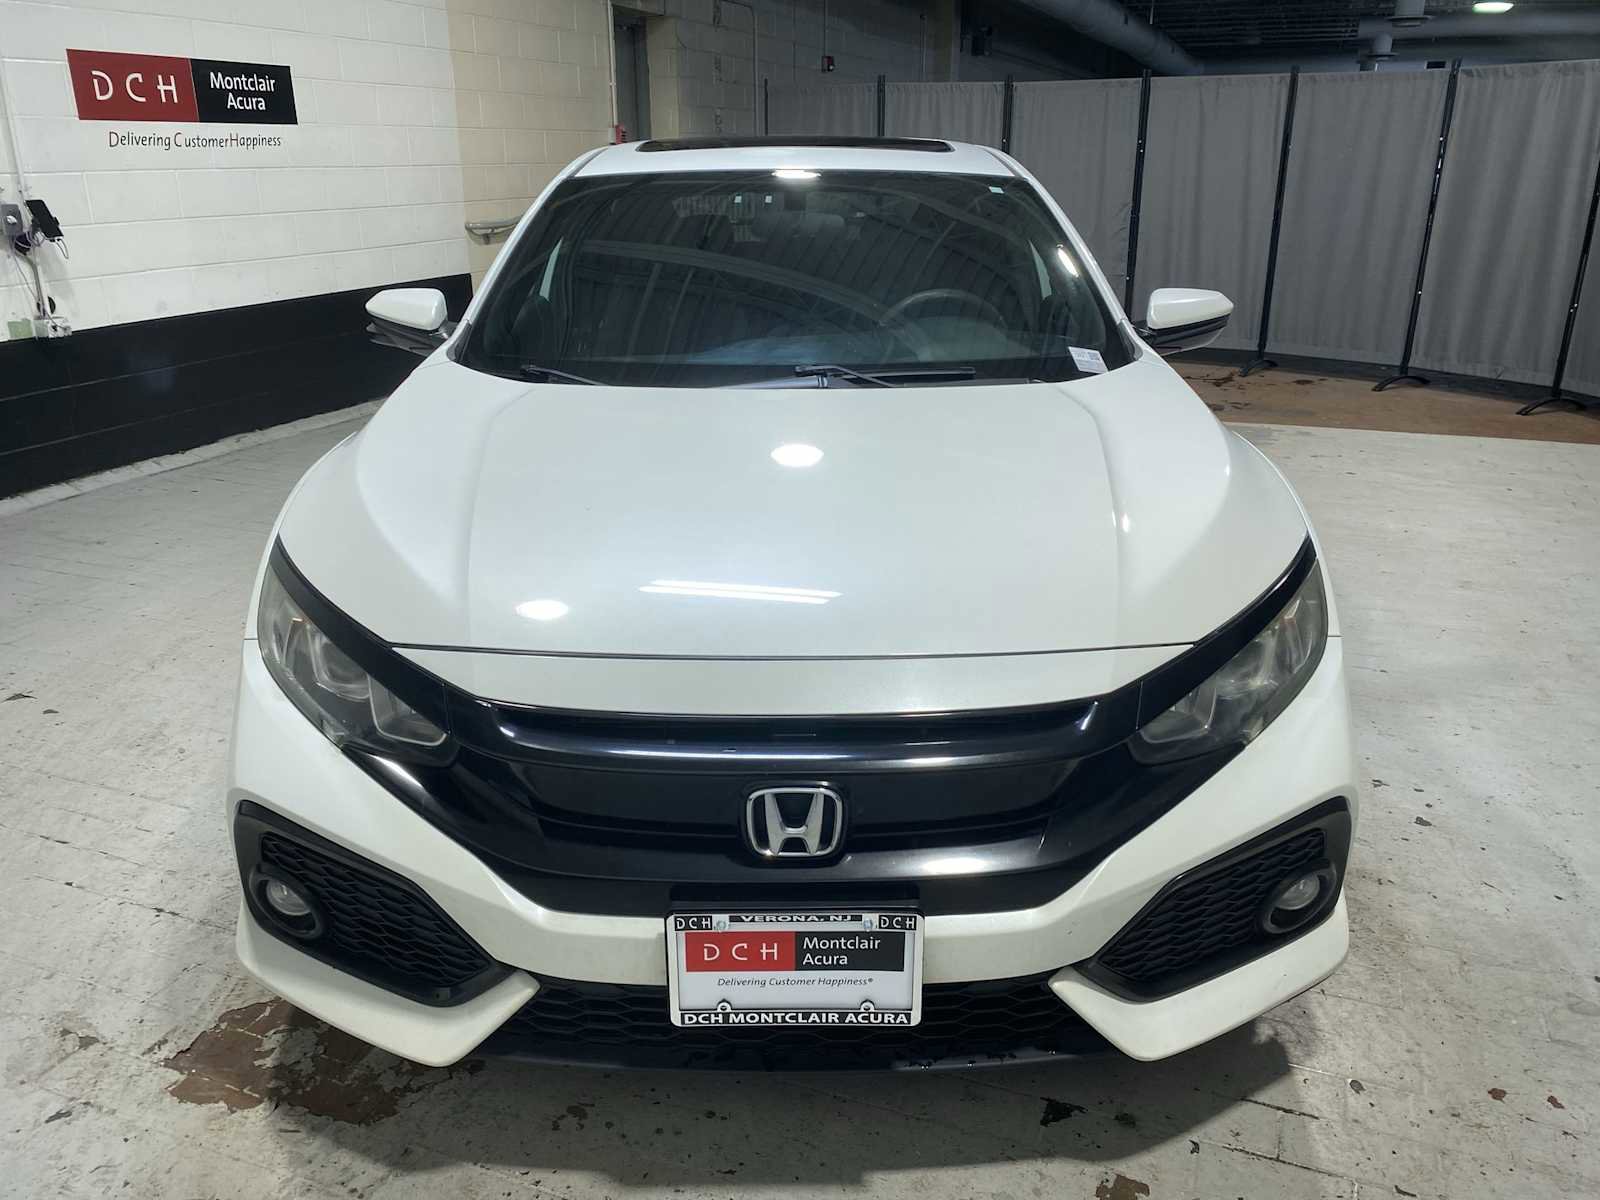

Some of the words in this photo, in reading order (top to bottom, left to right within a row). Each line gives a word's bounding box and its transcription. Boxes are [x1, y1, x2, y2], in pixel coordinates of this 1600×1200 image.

[91, 70, 178, 103] DCH
[209, 72, 276, 92] Montclair
[226, 93, 266, 111] Acura
[108, 131, 171, 151] Delivering
[173, 132, 229, 148] Customer
[229, 134, 282, 150] Happiness
[676, 917, 712, 930] DCH
[880, 916, 916, 929] DCH
[803, 936, 881, 950] Montclair
[703, 943, 778, 961] DCH
[802, 953, 849, 966] Acura
[717, 977, 767, 988] Delivering
[769, 977, 816, 986] Customer
[684, 1013, 723, 1024] DCH
[729, 1013, 841, 1024] MONTCLAIR
[845, 1013, 909, 1024] ACURA
